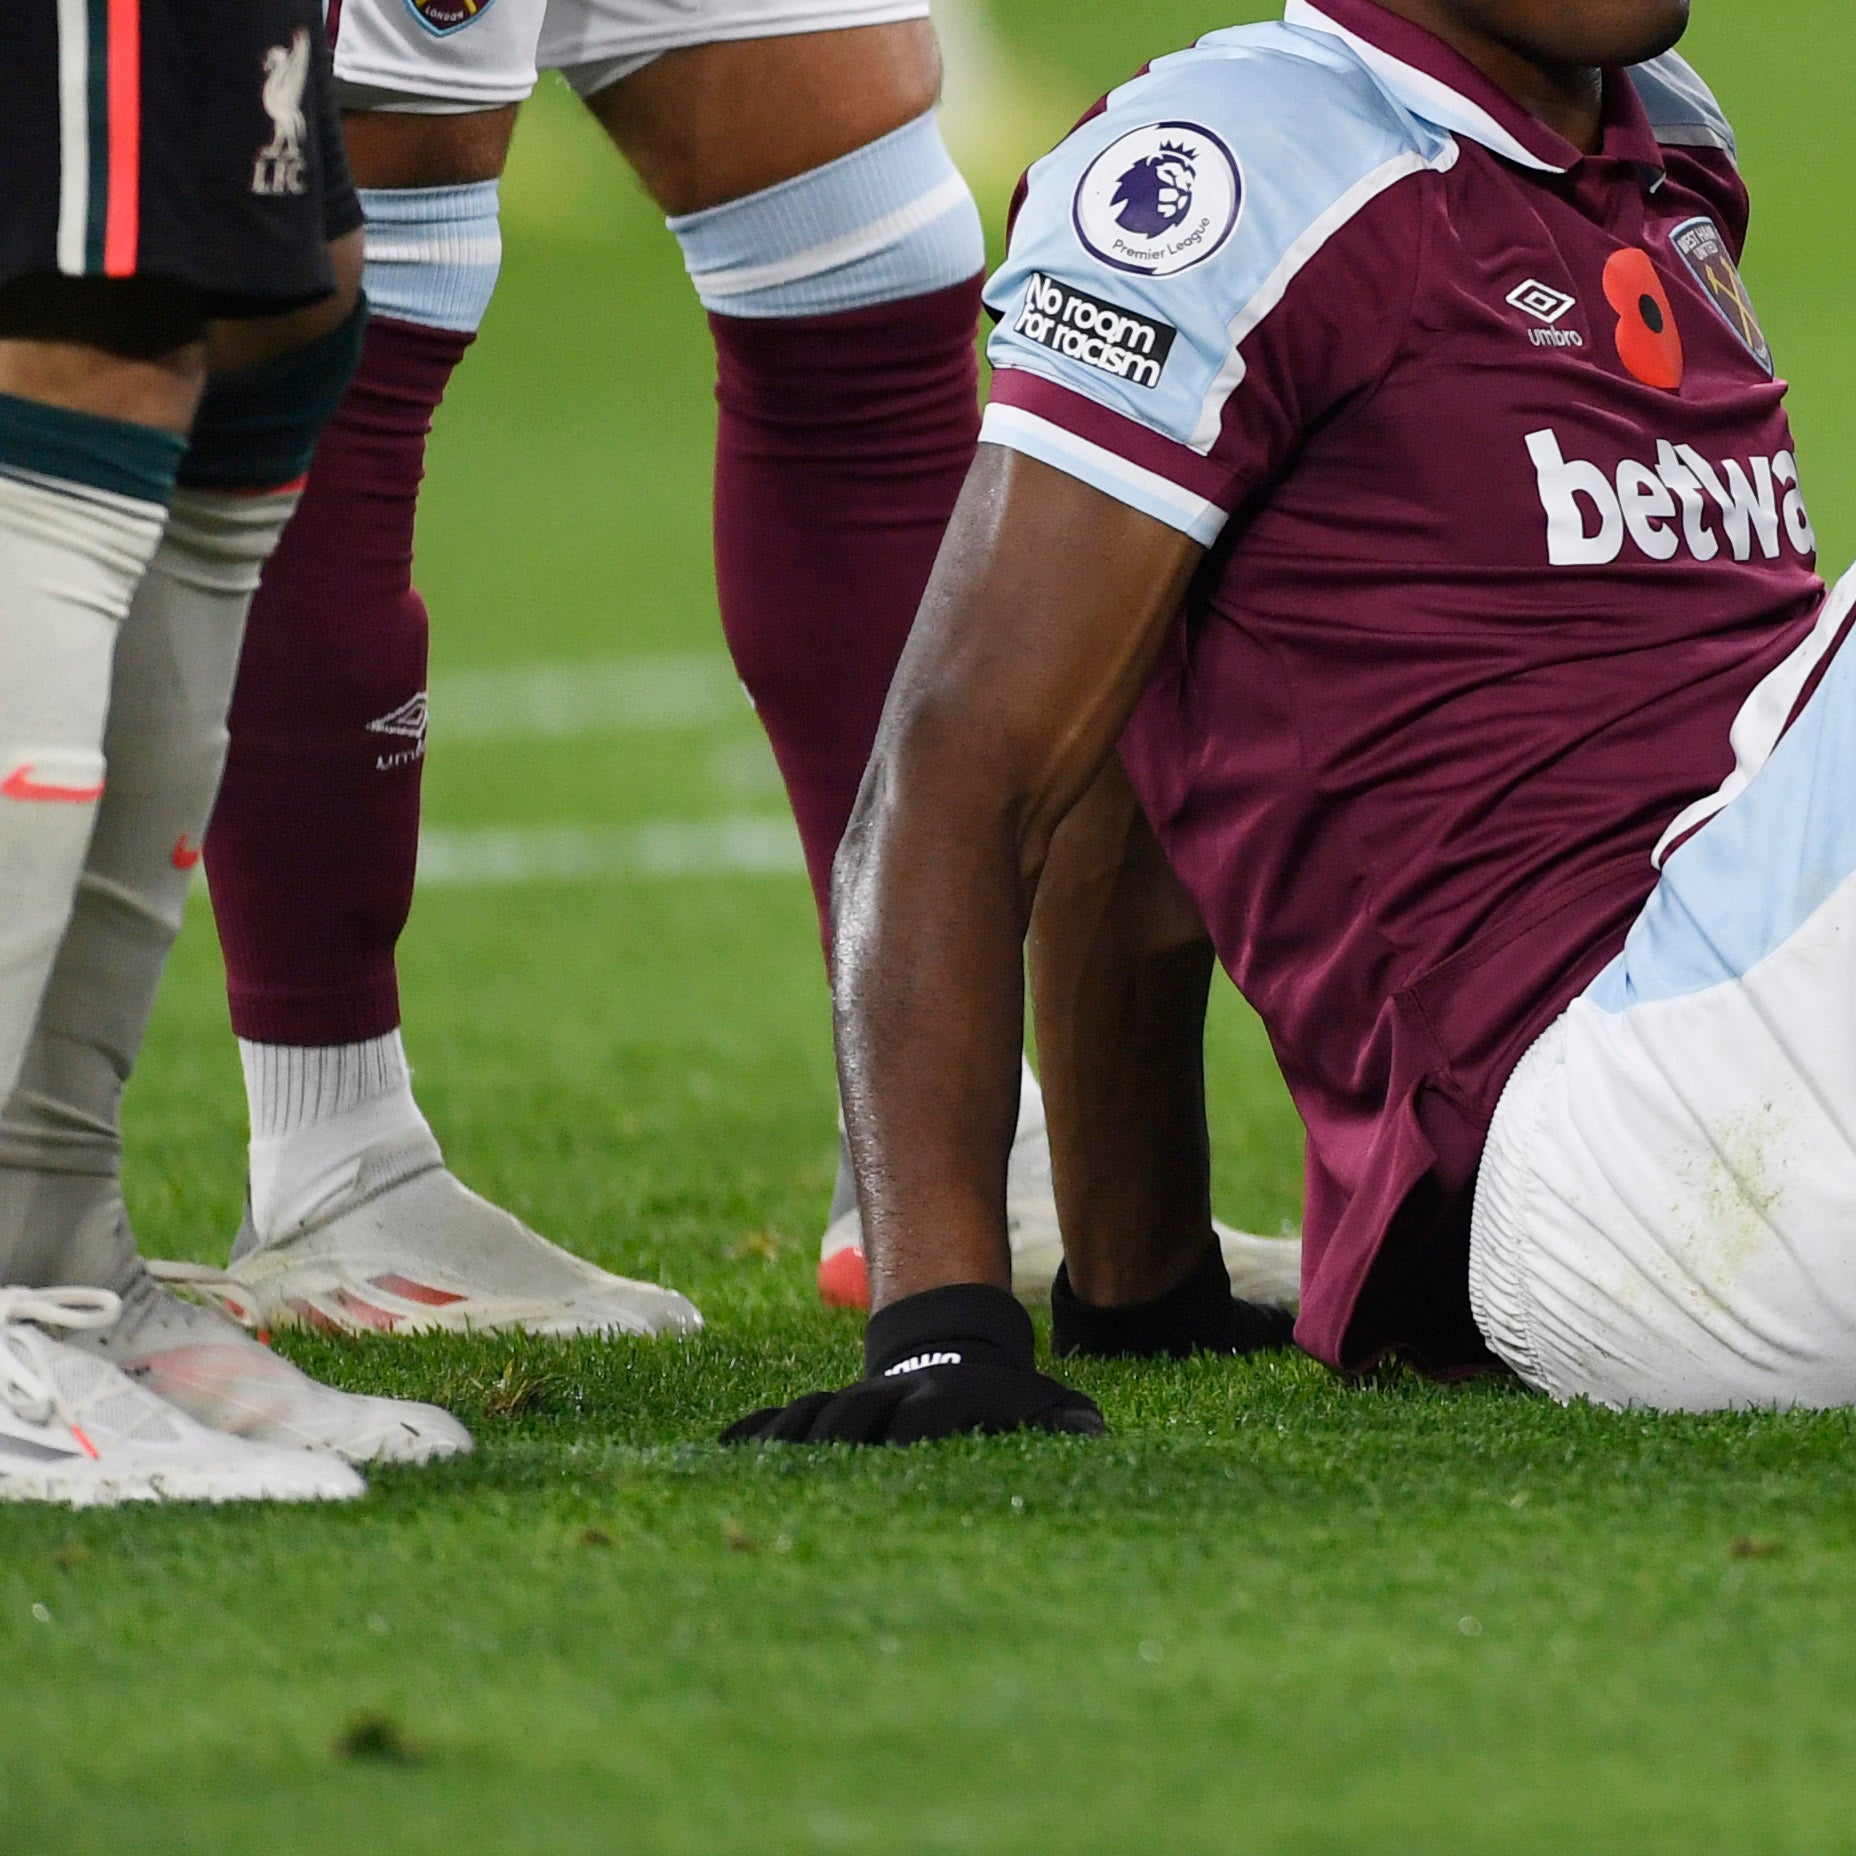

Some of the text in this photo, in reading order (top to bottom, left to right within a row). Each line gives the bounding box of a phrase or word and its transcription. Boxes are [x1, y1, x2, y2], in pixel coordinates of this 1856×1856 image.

[1112, 216, 1211, 261] Premier League
[1014, 302, 1161, 388] for racism
[1026, 272, 1156, 354] No room
[1527, 324, 1583, 347] umbro
[1524, 428, 1817, 566] betwa
